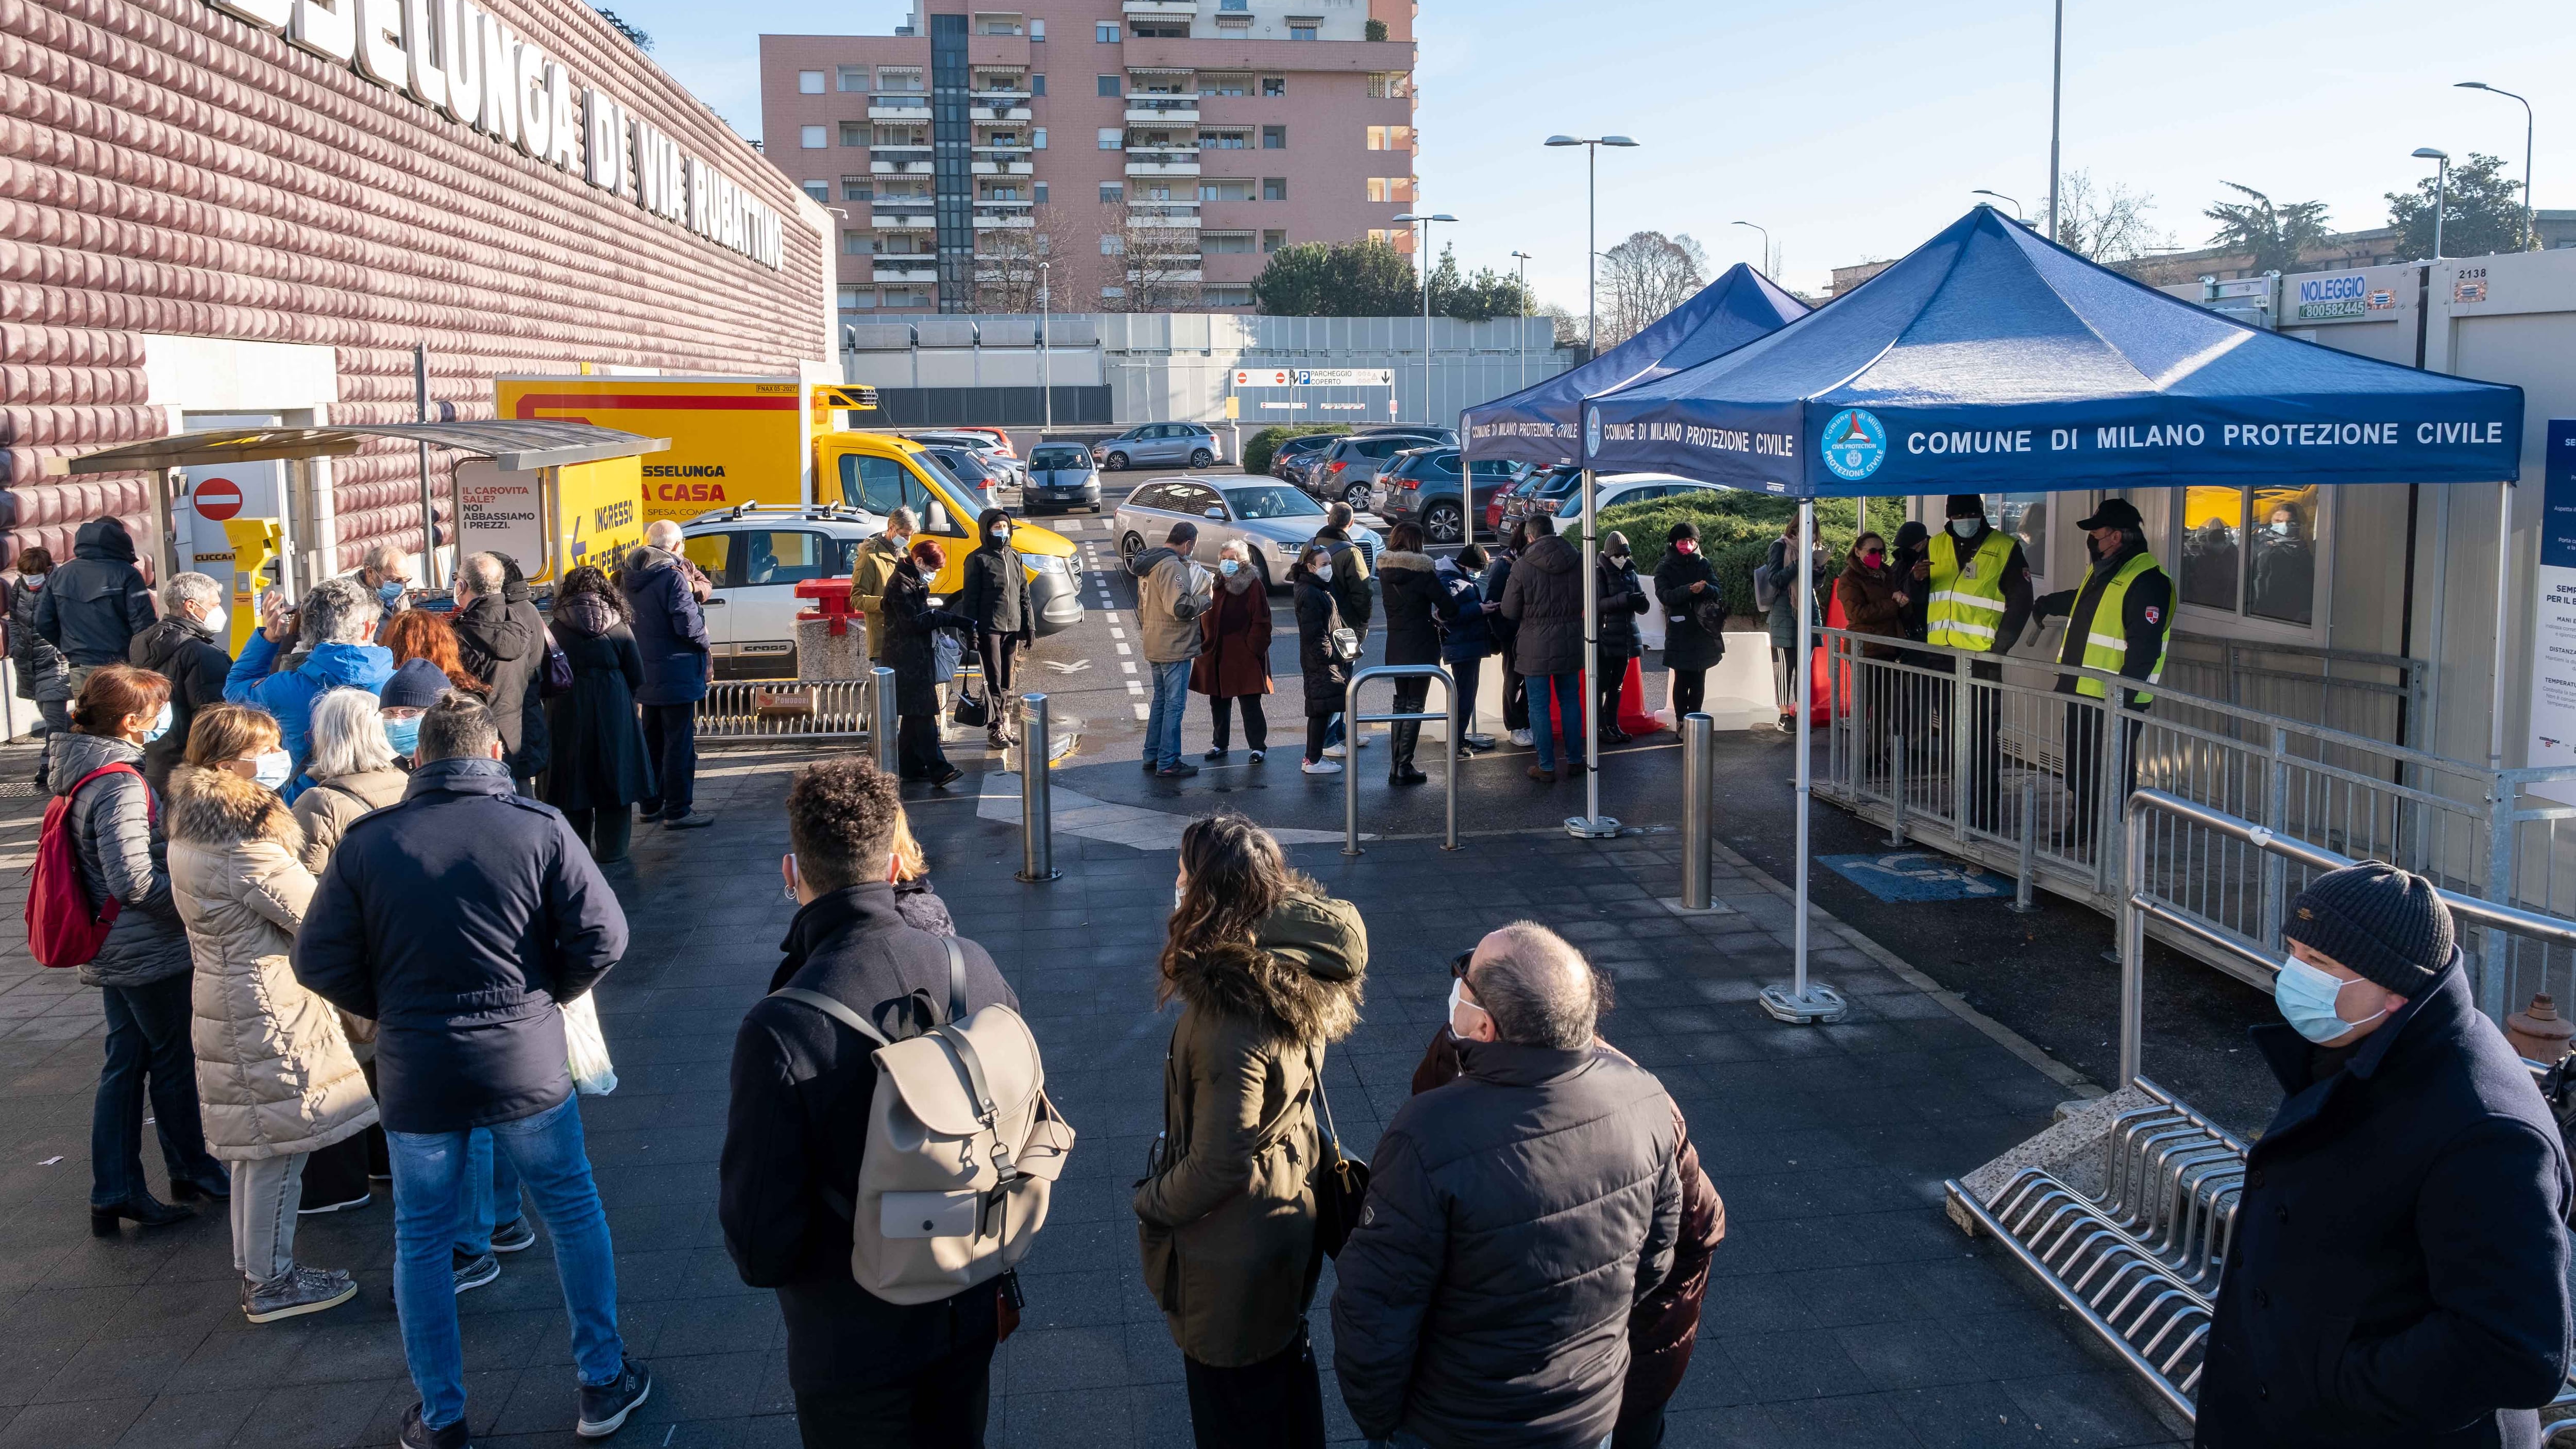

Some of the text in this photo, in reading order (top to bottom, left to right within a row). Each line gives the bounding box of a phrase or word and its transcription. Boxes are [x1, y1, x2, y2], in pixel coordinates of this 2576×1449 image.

[206, 0, 784, 272] ELUNGA DI VIA RUBATTINO
[2459, 268, 2486, 279] 2138
[2301, 276, 2365, 301] NOLEGGIO
[2307, 302, 2364, 317] 800582445
[1472, 422, 1577, 438] COMUNE DI MILANO PROTEZIONE CIVILE
[1604, 422, 1793, 457] COMUNE DI MILANO PROTEZIONE CIVILE
[1824, 414, 1849, 440] Comune
[1867, 415, 1883, 439] Milano
[1908, 422, 2502, 454] COMUNE DI MILANO PROTEZIONE CIVILE
[642, 466, 725, 477] SSELUNGA
[1825, 449, 1884, 477] PROTEZIONE CIVILE
[658, 484, 726, 501] CASA
[595, 499, 633, 533] INGRESSO
[2547, 595, 2562, 603] PER
